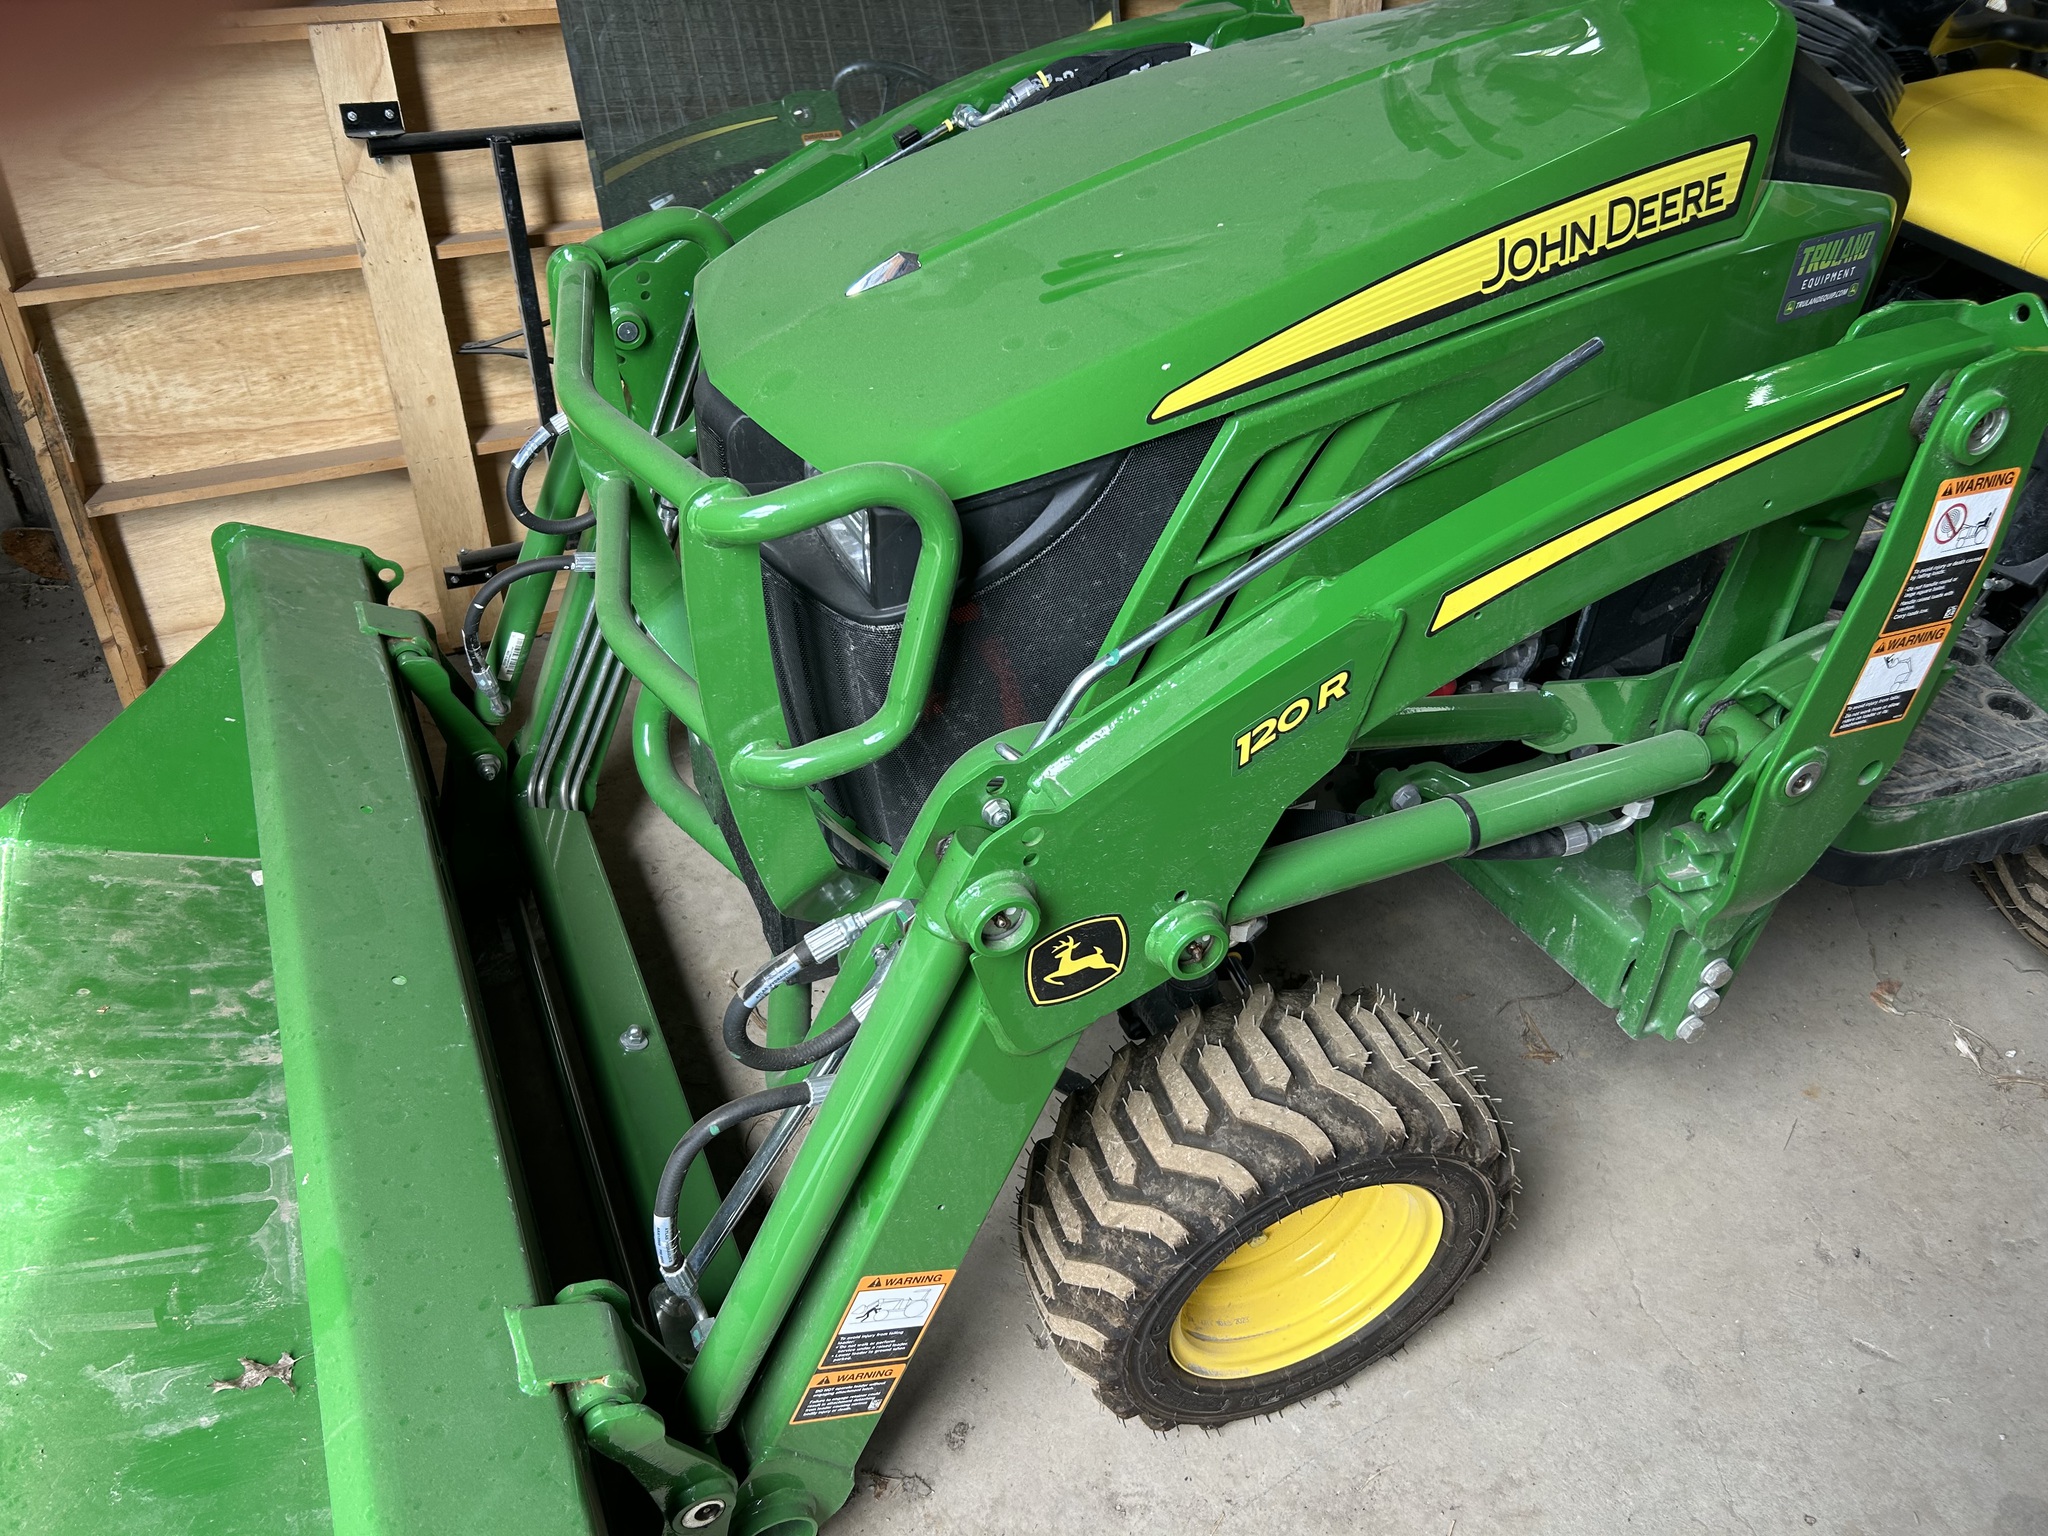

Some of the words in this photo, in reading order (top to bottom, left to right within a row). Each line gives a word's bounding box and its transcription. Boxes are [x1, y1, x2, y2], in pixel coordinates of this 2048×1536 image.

[1481, 214, 1597, 291] JOHN
[1605, 171, 1728, 248] DEERE
[1797, 231, 1876, 276] TRULAND
[1801, 266, 1856, 290] EQUIPMENT
[1795, 288, 1849, 309] TRULANDEQUIP.COM
[1955, 471, 2015, 495] WARNING
[1887, 627, 1946, 651] WARNING
[1235, 696, 1313, 770] 120
[1316, 669, 1351, 714] R
[885, 1274, 943, 1287] WARNING
[837, 1369, 894, 1382] WARNING
